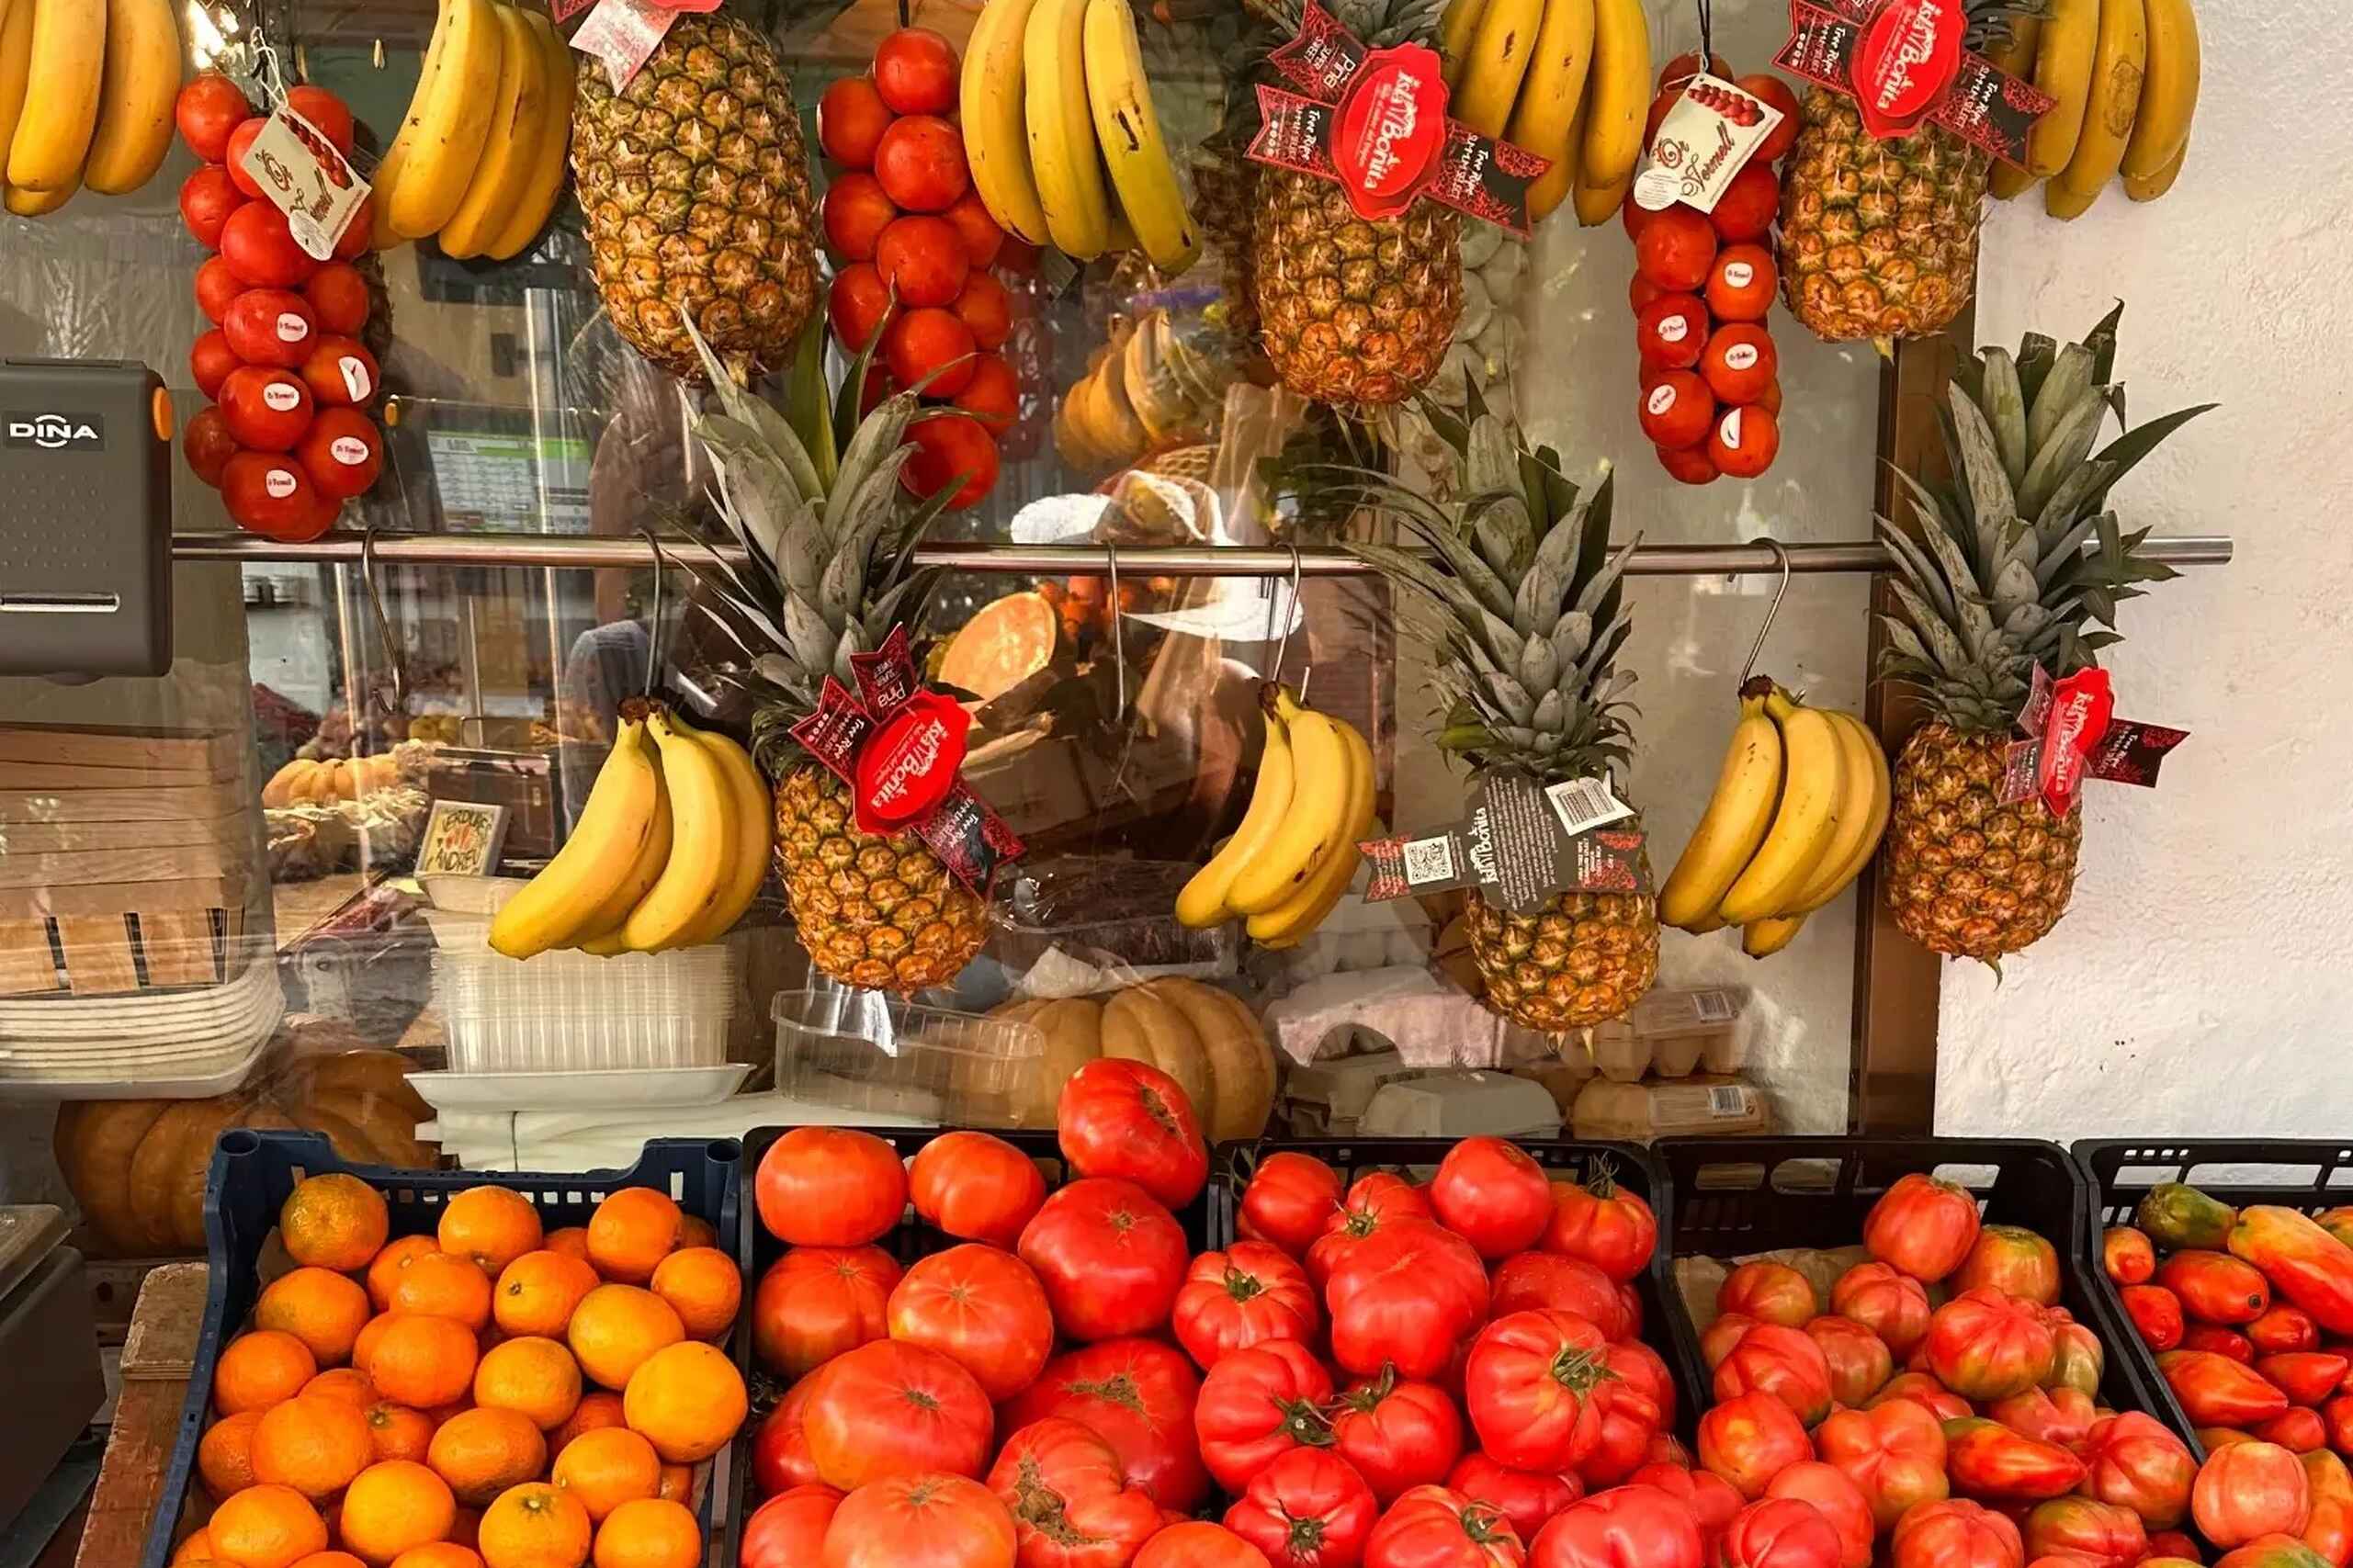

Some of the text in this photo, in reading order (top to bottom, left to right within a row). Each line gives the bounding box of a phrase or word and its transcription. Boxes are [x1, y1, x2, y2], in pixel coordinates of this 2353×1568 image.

[1323, 53, 1356, 88] Piña
[1823, 28, 1846, 74] Tree Ripe
[1969, 82, 1998, 126] Tree Ripe
[1299, 109, 1321, 162] Tree Ripe
[1465, 150, 1488, 196] Tree Ripe
[9, 423, 98, 439] DINA
[877, 682, 906, 707] Piña
[834, 718, 865, 760] Tree Ripe
[871, 753, 919, 808] Bonita
[1476, 807, 1493, 852] Bonita
